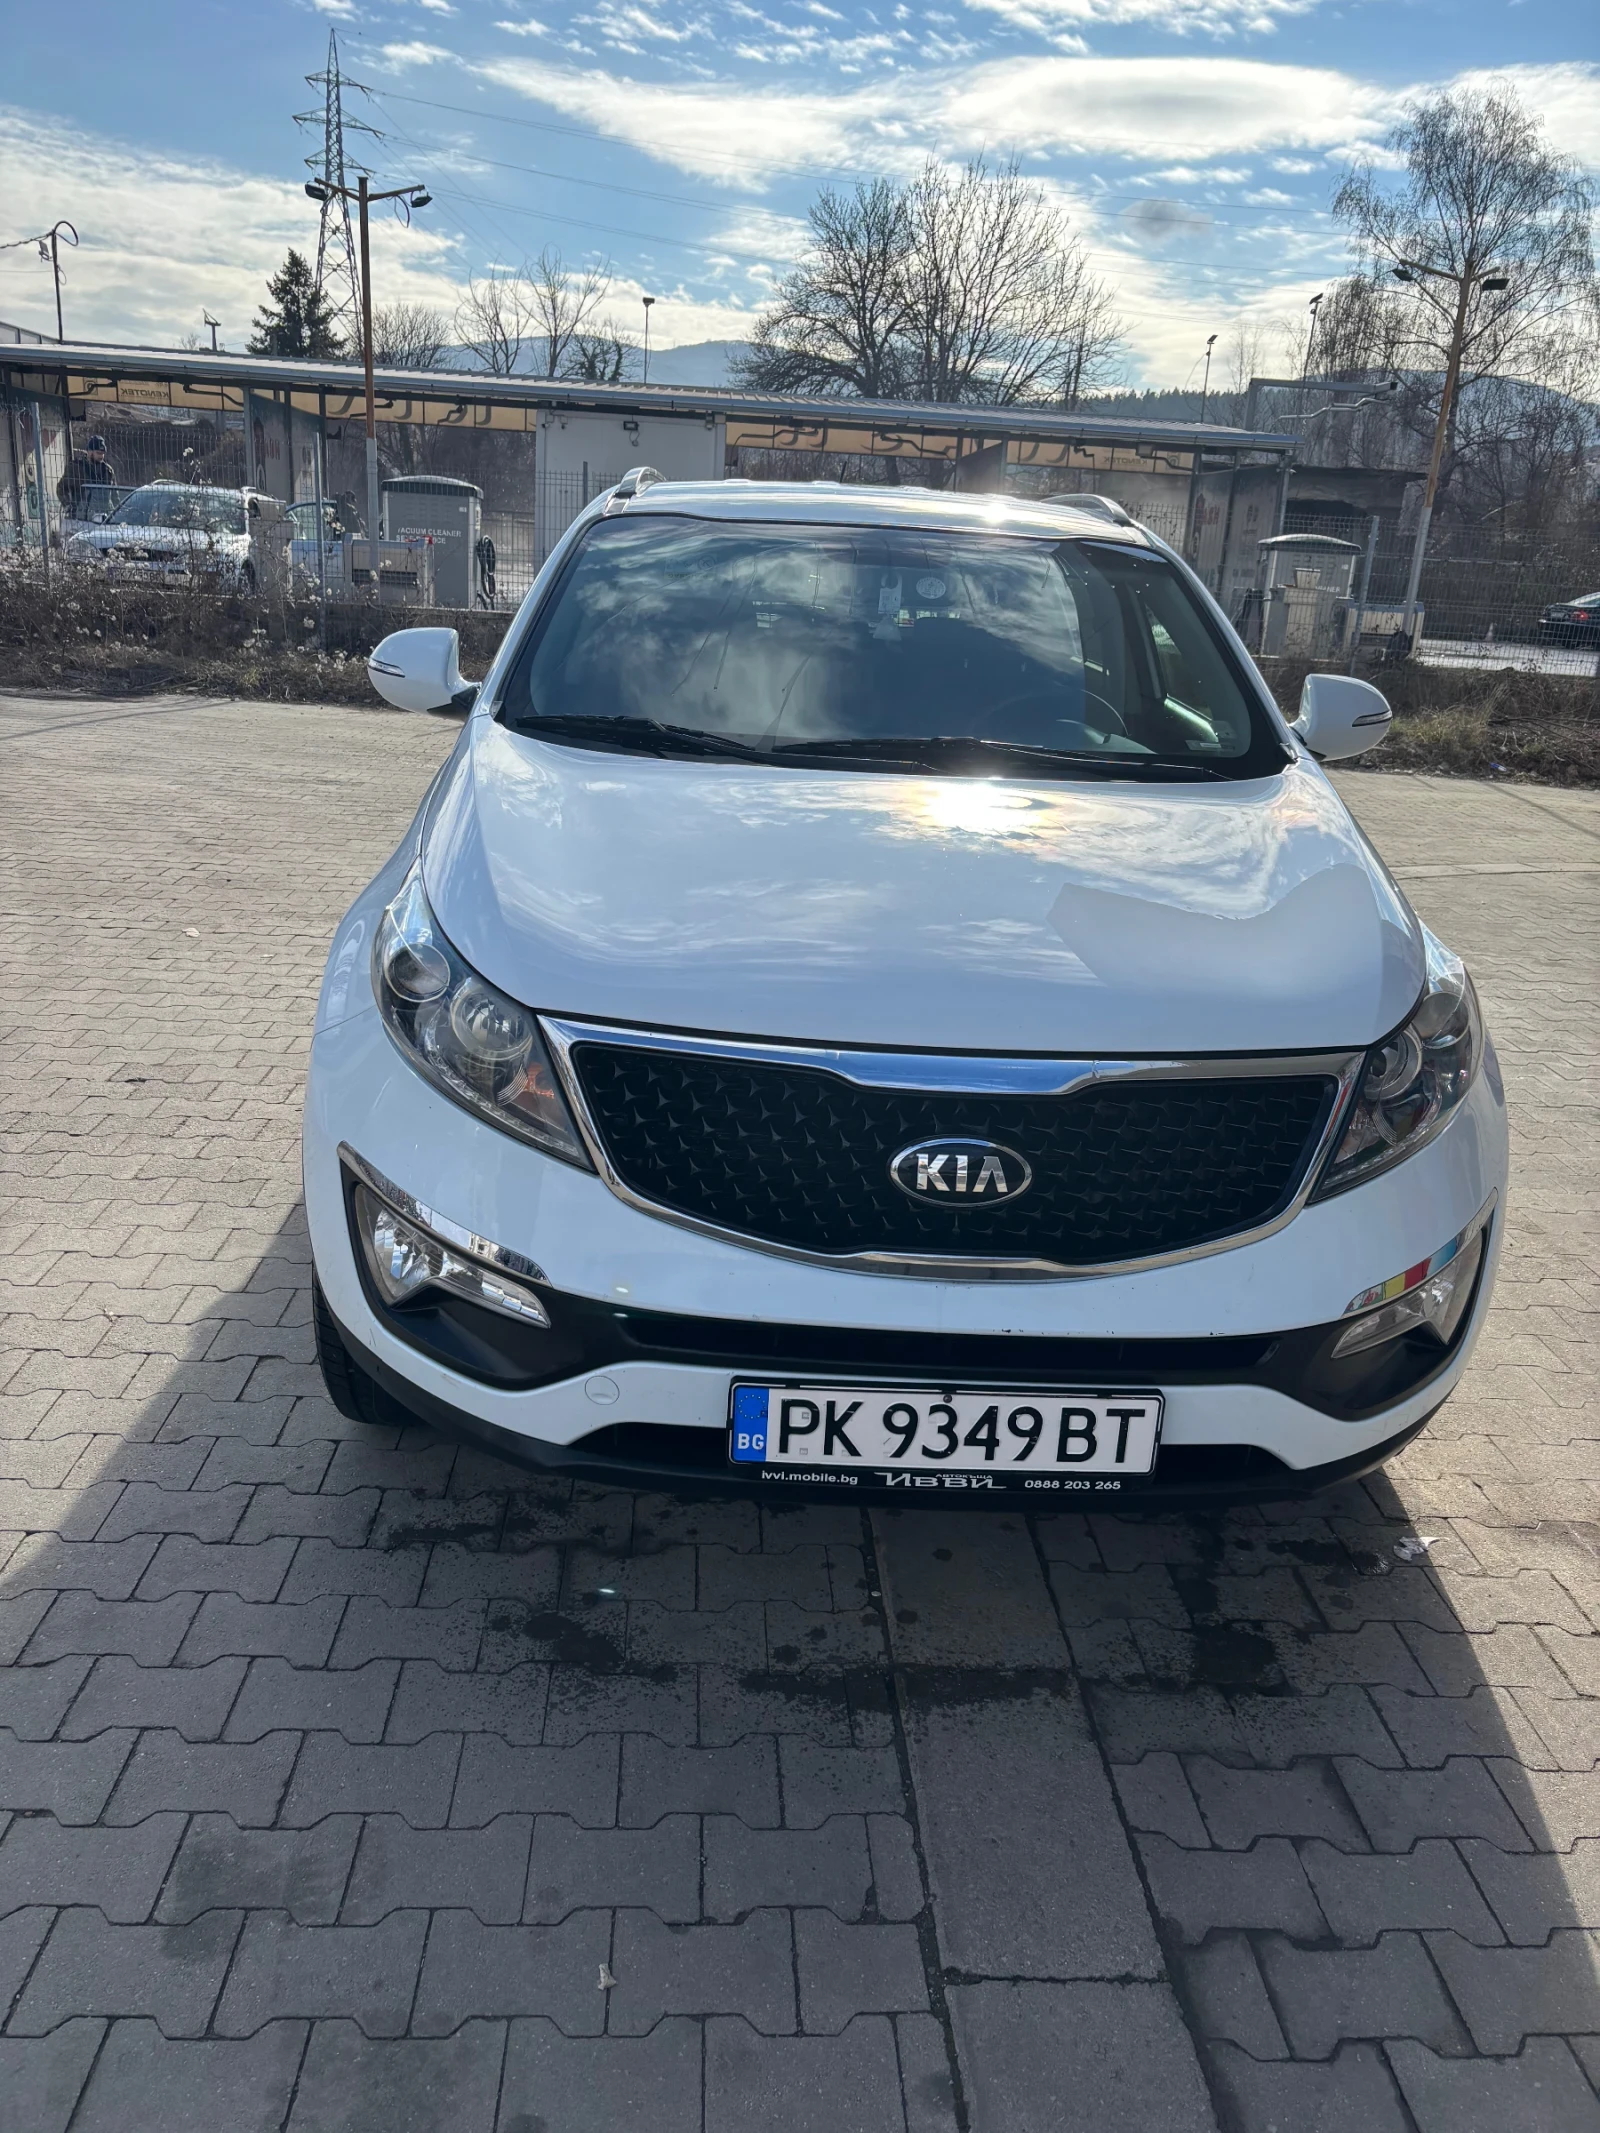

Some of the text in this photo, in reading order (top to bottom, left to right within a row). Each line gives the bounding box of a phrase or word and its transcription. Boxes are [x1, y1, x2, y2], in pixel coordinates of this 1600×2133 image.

[428, 528, 462, 538] CLEANER
[916, 1153, 1008, 1193] KIA
[778, 1399, 1146, 1463] PK 9349 BT
[738, 1433, 764, 1450] BG
[761, 1470, 859, 1485] ivvi.mobile.bg
[1024, 1479, 1121, 1490] 0888 203 265
